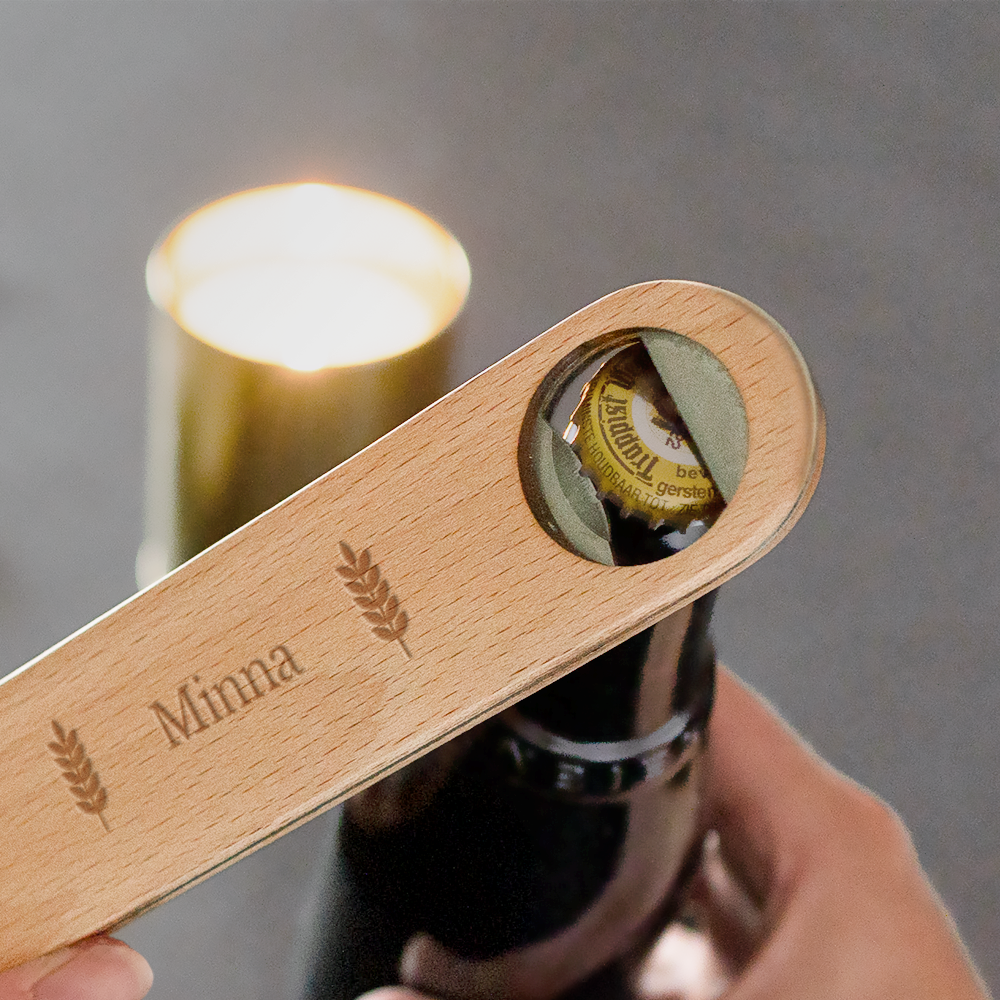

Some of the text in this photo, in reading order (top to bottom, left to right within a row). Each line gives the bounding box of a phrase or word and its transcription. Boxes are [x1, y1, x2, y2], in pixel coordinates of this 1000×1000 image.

[588, 441, 642, 503] HOUDBAAR
[601, 394, 659, 486] Trappist
[149, 644, 305, 750] Minna
